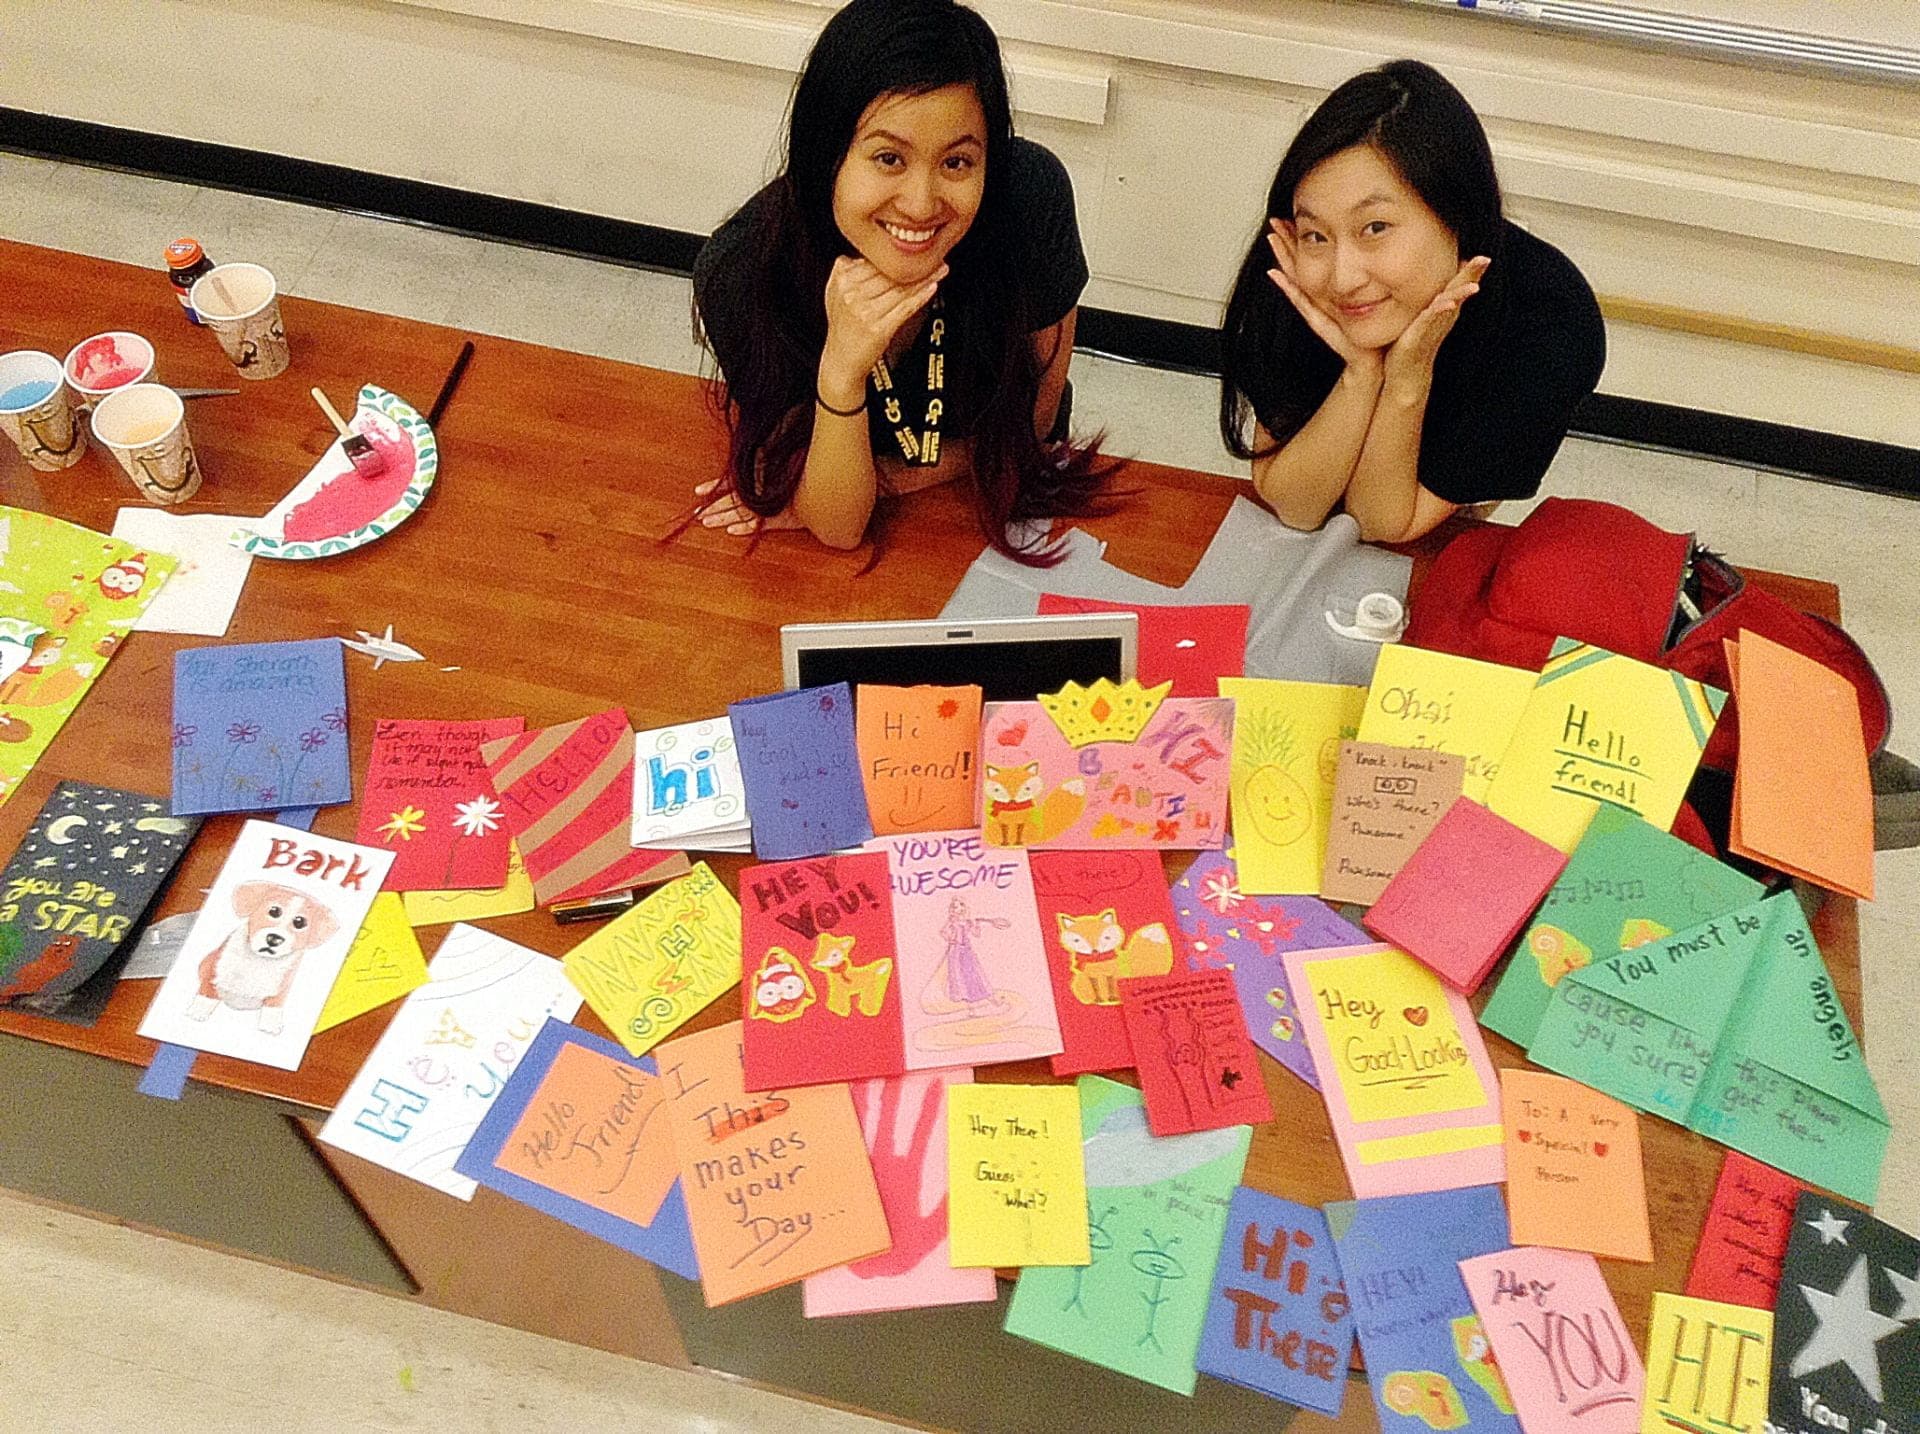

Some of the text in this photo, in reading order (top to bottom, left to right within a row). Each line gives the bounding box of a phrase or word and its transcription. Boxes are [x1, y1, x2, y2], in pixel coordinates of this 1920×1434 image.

[884, 711, 921, 740] Hi
[1380, 686, 1455, 725] Ohai
[1562, 703, 1641, 767] Hello
[647, 747, 720, 815] hi
[873, 751, 971, 781] Friend!
[263, 837, 372, 891] Bark
[892, 836, 984, 867] YOU'RE
[4, 876, 117, 908] you are
[752, 859, 841, 913] HEY
[0, 900, 132, 945] a STAR
[1606, 955, 1659, 985] You
[1666, 923, 1727, 964] must
[1733, 915, 1761, 936] be
[1785, 928, 1811, 959] an
[1318, 987, 1385, 1030] Hey
[665, 1062, 710, 1100] I
[691, 1090, 790, 1138] This
[968, 1114, 999, 1140] Hey
[694, 1130, 806, 1190] makes
[975, 1160, 1017, 1183] Guess
[724, 1163, 807, 1224] your
[1241, 1221, 1315, 1296] Hi
[1510, 1307, 1630, 1403] YOU
